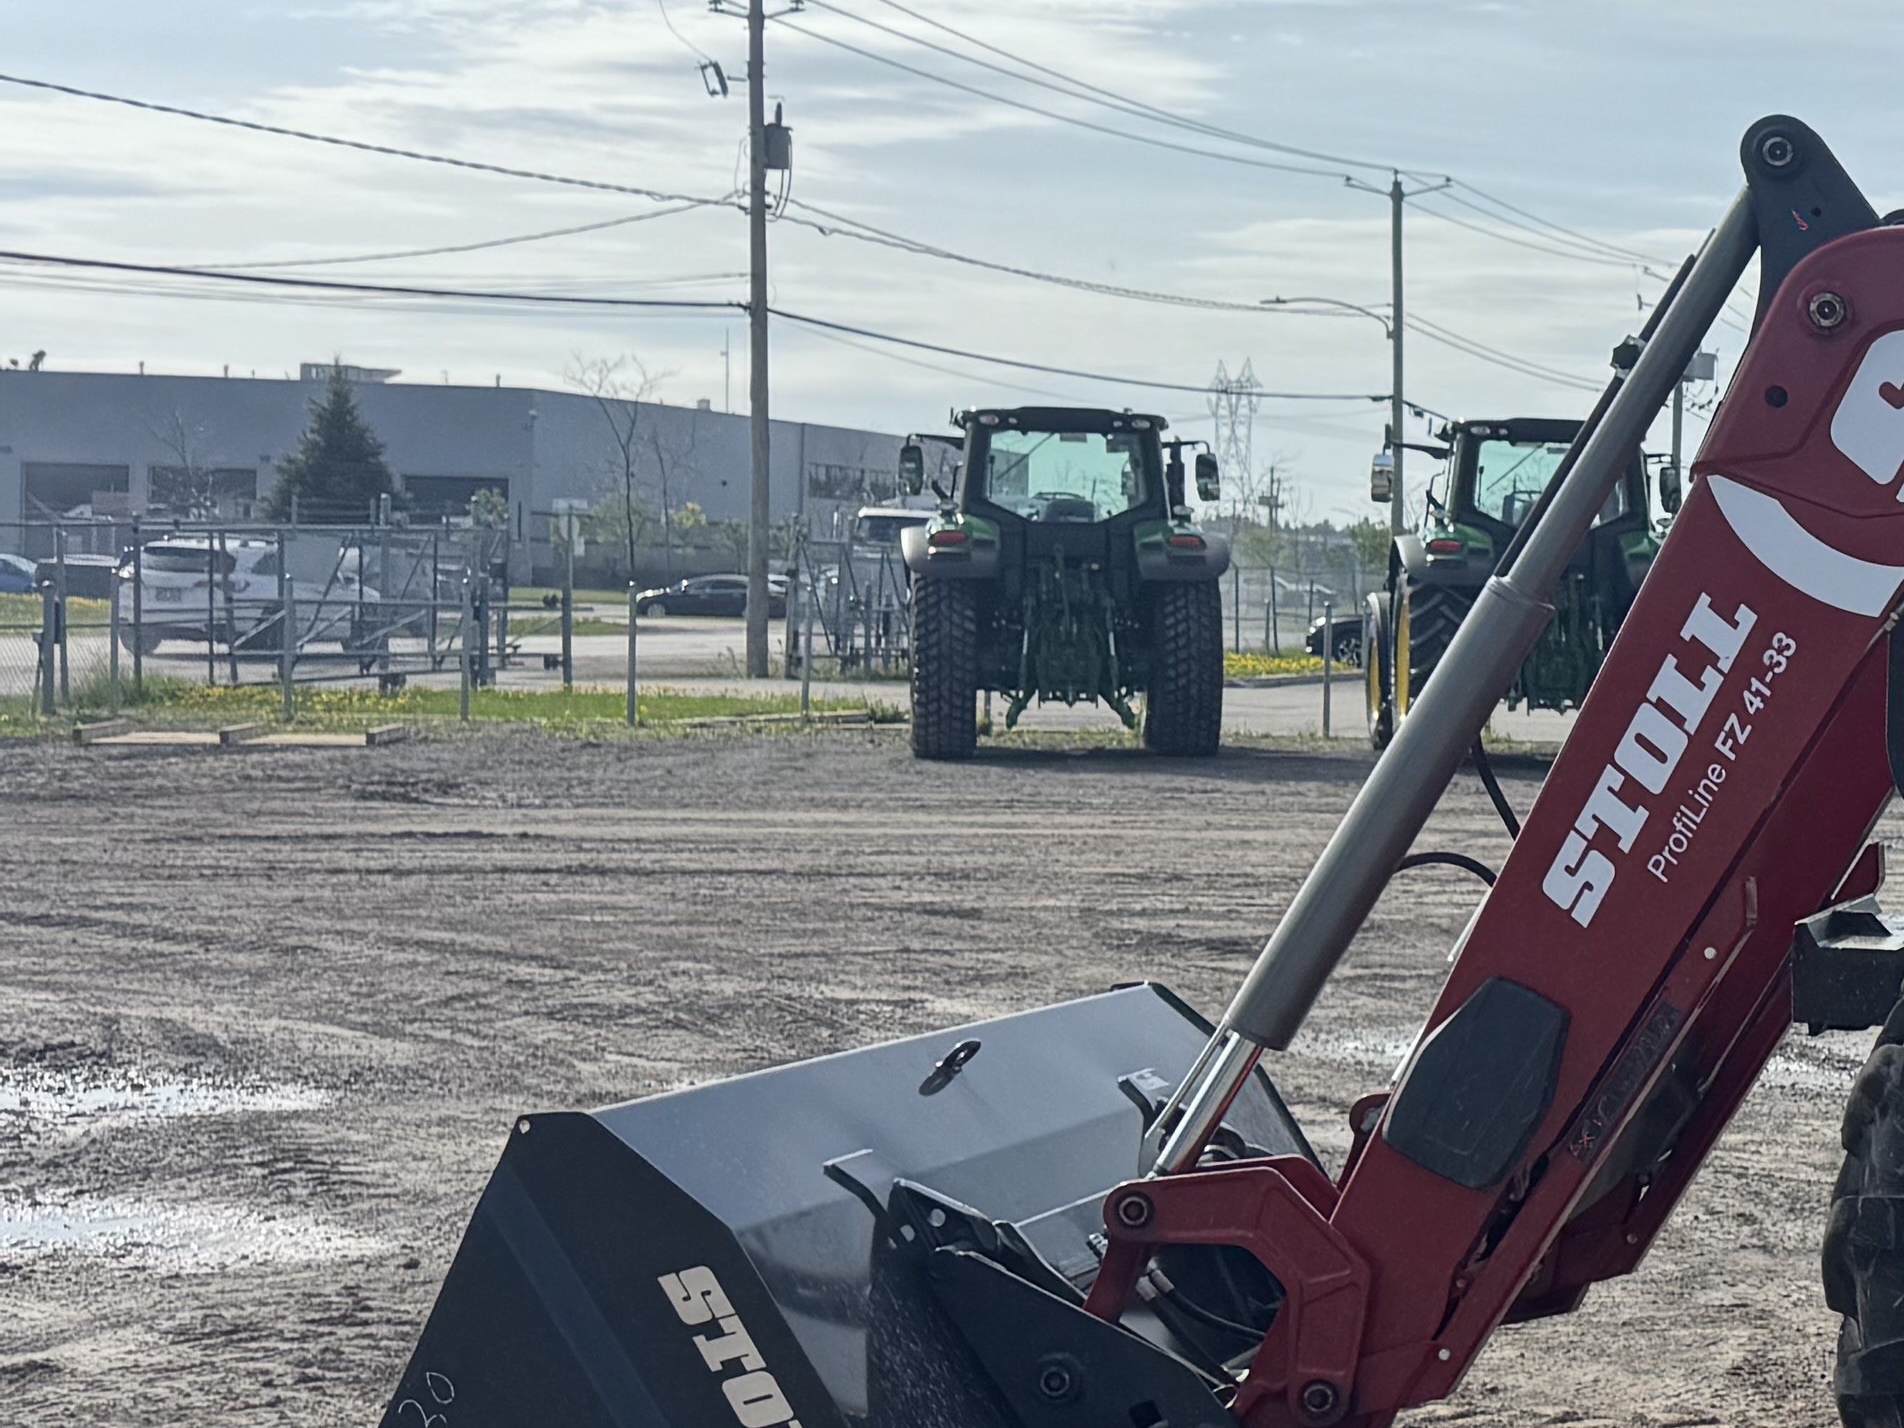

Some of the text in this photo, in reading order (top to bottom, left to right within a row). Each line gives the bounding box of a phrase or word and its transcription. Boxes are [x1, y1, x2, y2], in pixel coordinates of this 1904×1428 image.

[1541, 591, 1759, 929] STOLL
[1646, 631, 1797, 883] ProfiLine FZ 41-33
